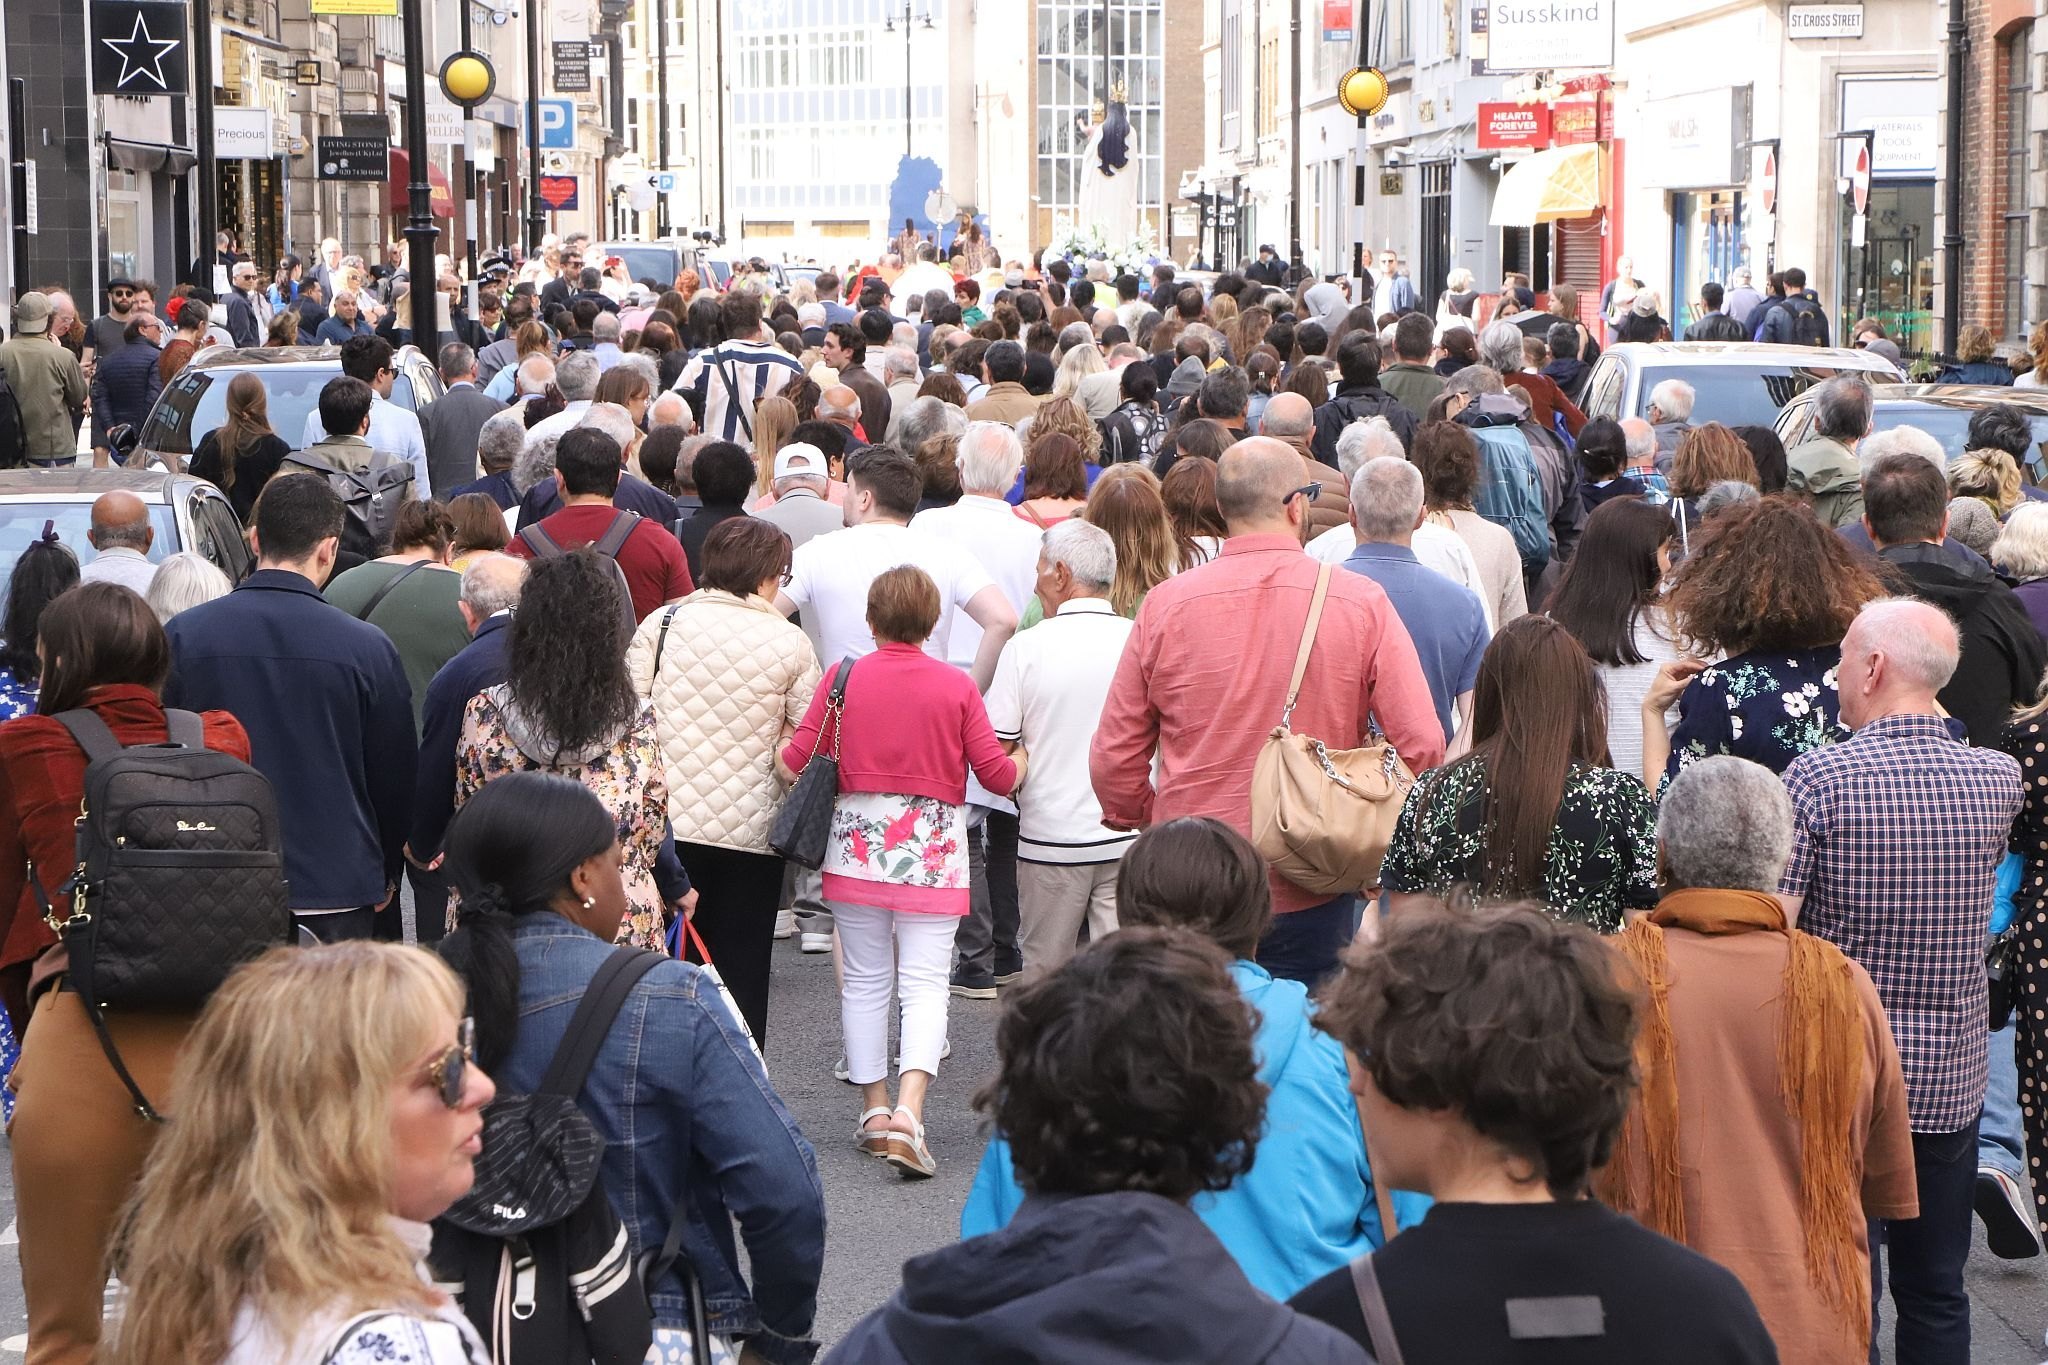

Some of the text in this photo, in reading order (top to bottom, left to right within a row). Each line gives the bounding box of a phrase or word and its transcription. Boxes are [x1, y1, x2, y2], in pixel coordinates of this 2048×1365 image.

[1497, 1, 1599, 24] Susskind
[1804, 13, 1831, 27] CROSS
[1832, 13, 1861, 27] STREET
[1493, 111, 1534, 121] HEARTS
[1489, 121, 1538, 131] FOREVER
[1872, 122, 1923, 132] MATERIALS
[217, 128, 265, 139] Precious
[1883, 137, 1912, 146] TOOLS
[1874, 152, 1921, 162] QUIPMENT
[1206, 205, 1236, 215] CSH
[493, 1204, 527, 1219] FILA
